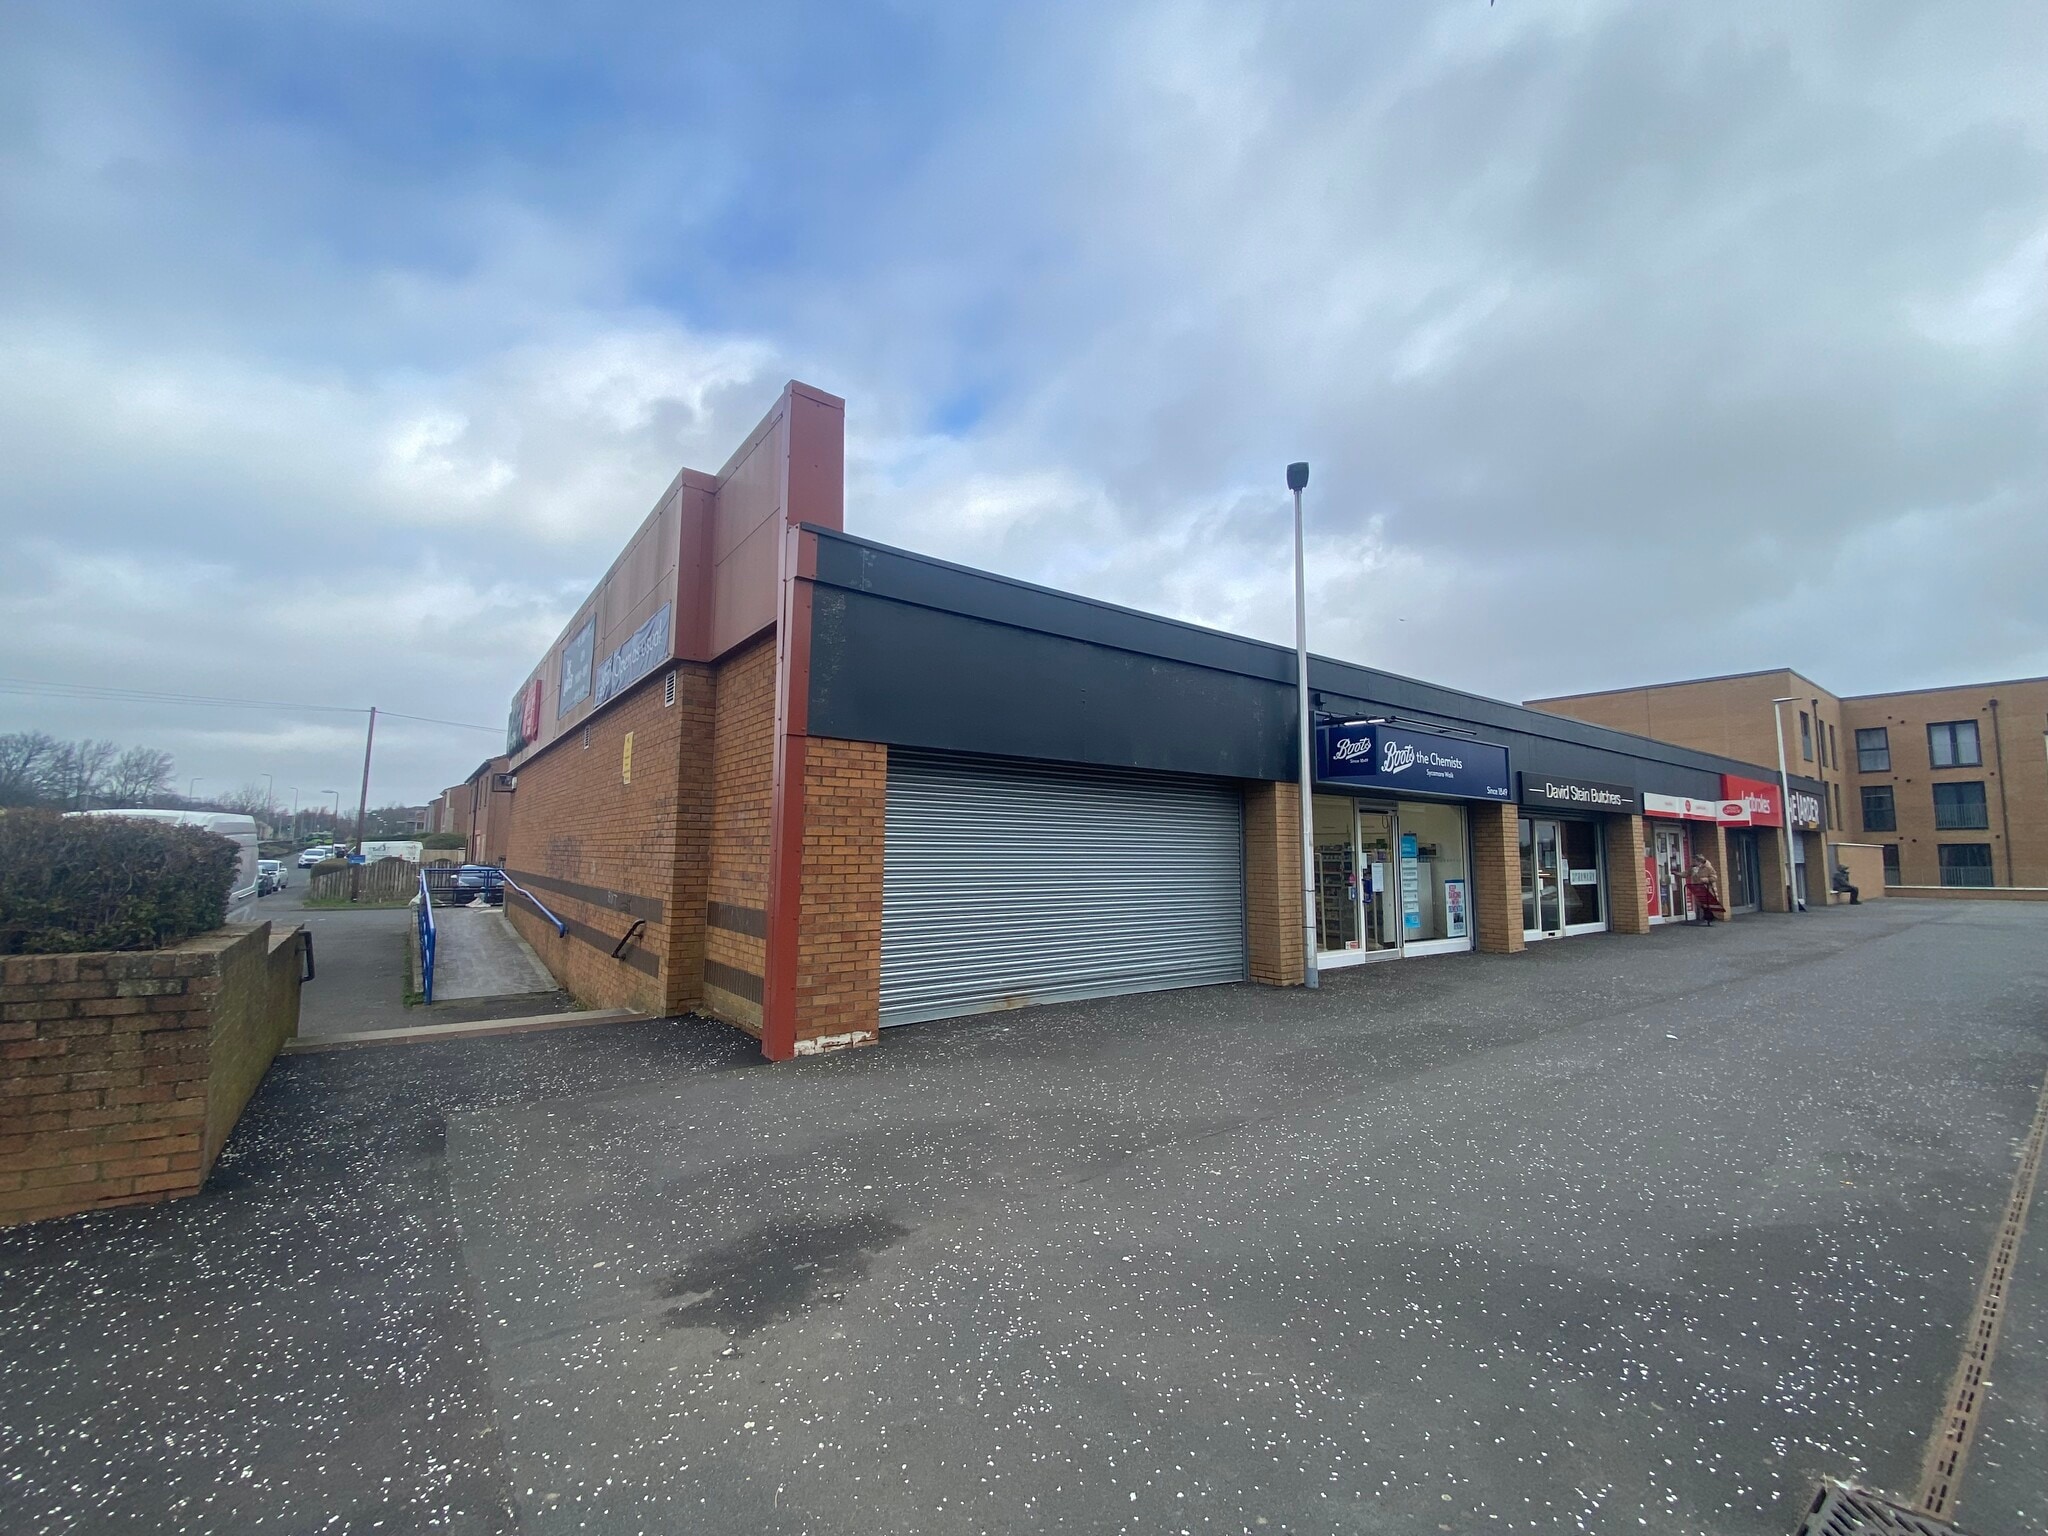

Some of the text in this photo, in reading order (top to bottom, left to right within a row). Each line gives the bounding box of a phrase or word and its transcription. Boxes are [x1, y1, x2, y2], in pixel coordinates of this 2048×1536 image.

[1333, 737, 1371, 760] Boots
[1381, 741, 1463, 774] Boots the Chemists
[1426, 768, 1454, 779] Sycamore Walk
[1486, 785, 1508, 797] Since 1849
[1545, 782, 1622, 805] David Stein Butchers
[1741, 789, 1771, 814] Lbrokes
[1796, 791, 1820, 826] LARDER
